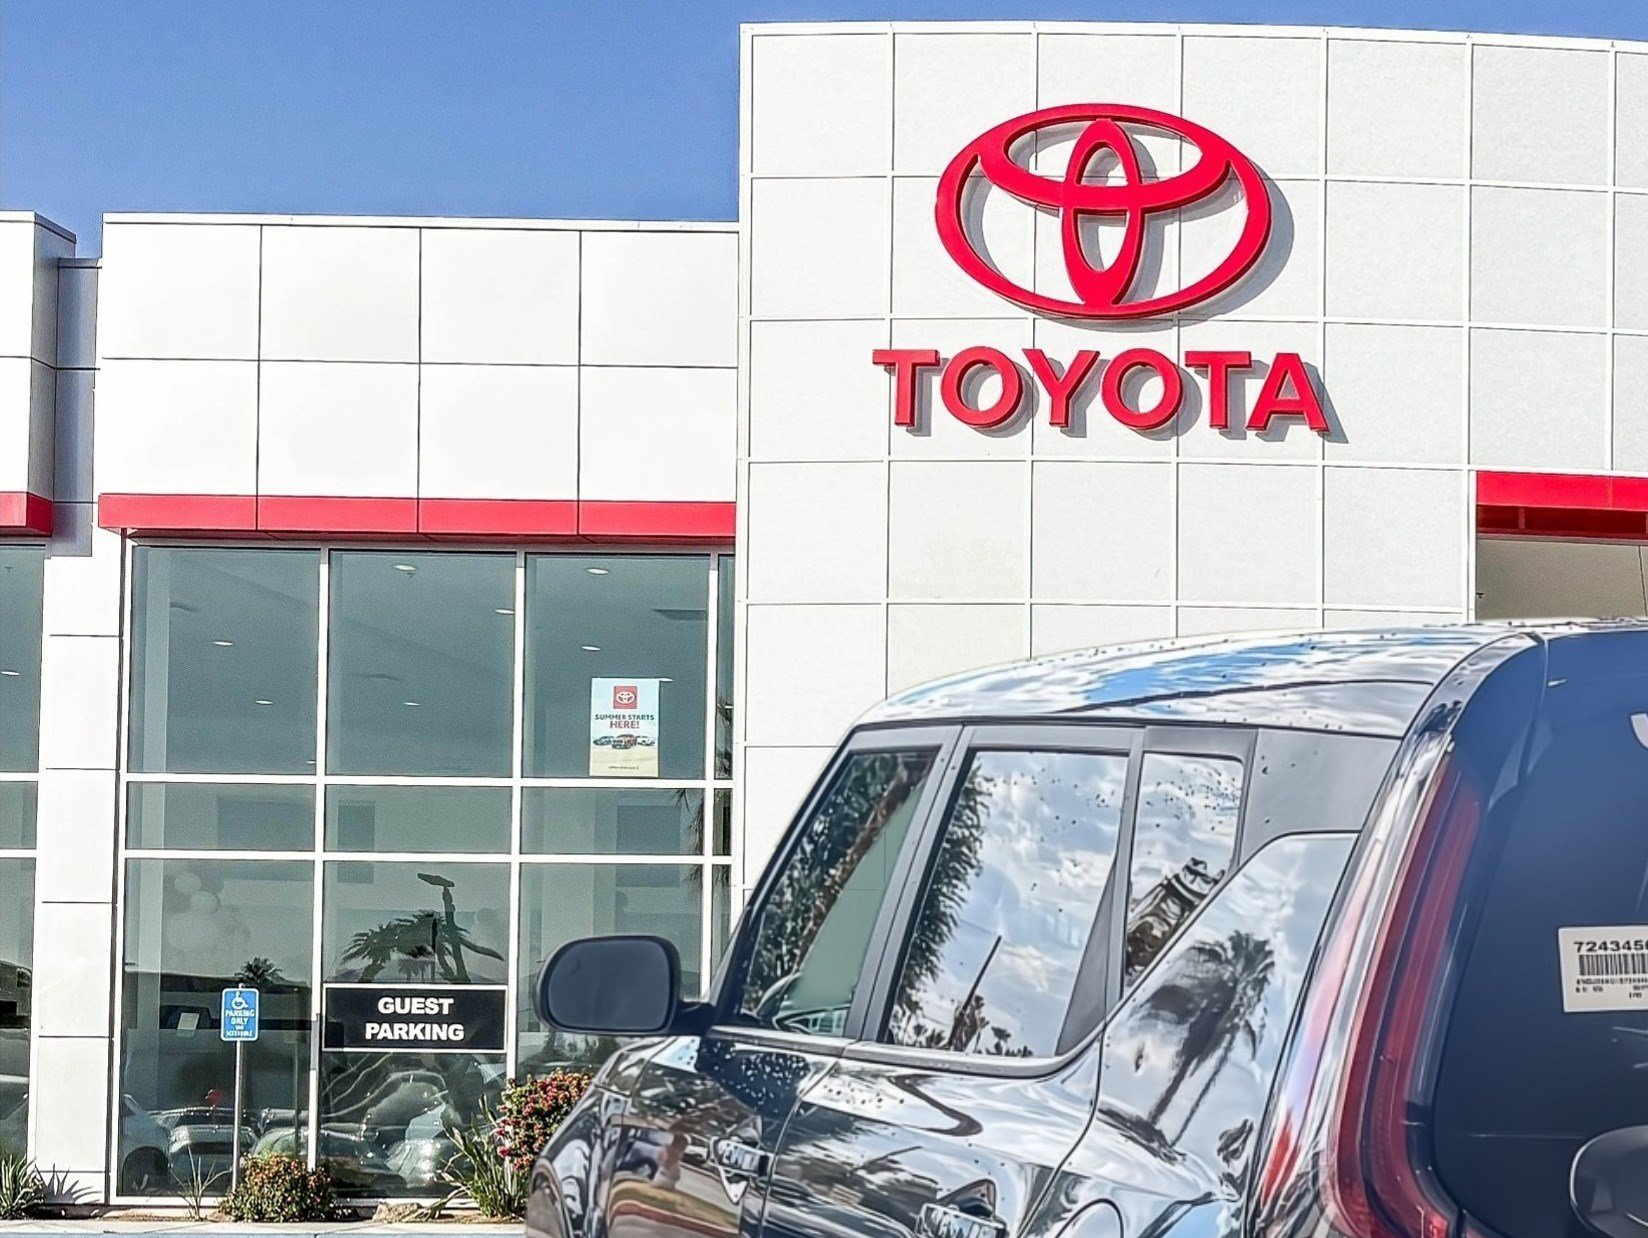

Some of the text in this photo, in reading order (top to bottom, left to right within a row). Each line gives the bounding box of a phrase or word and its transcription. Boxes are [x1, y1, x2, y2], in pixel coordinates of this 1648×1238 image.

[872, 346, 1331, 433] TOYOTA
[610, 720, 640, 729] HERE!
[225, 1009, 255, 1018] PARKING
[377, 997, 454, 1015] GUEST
[365, 1022, 465, 1041] PARKING
